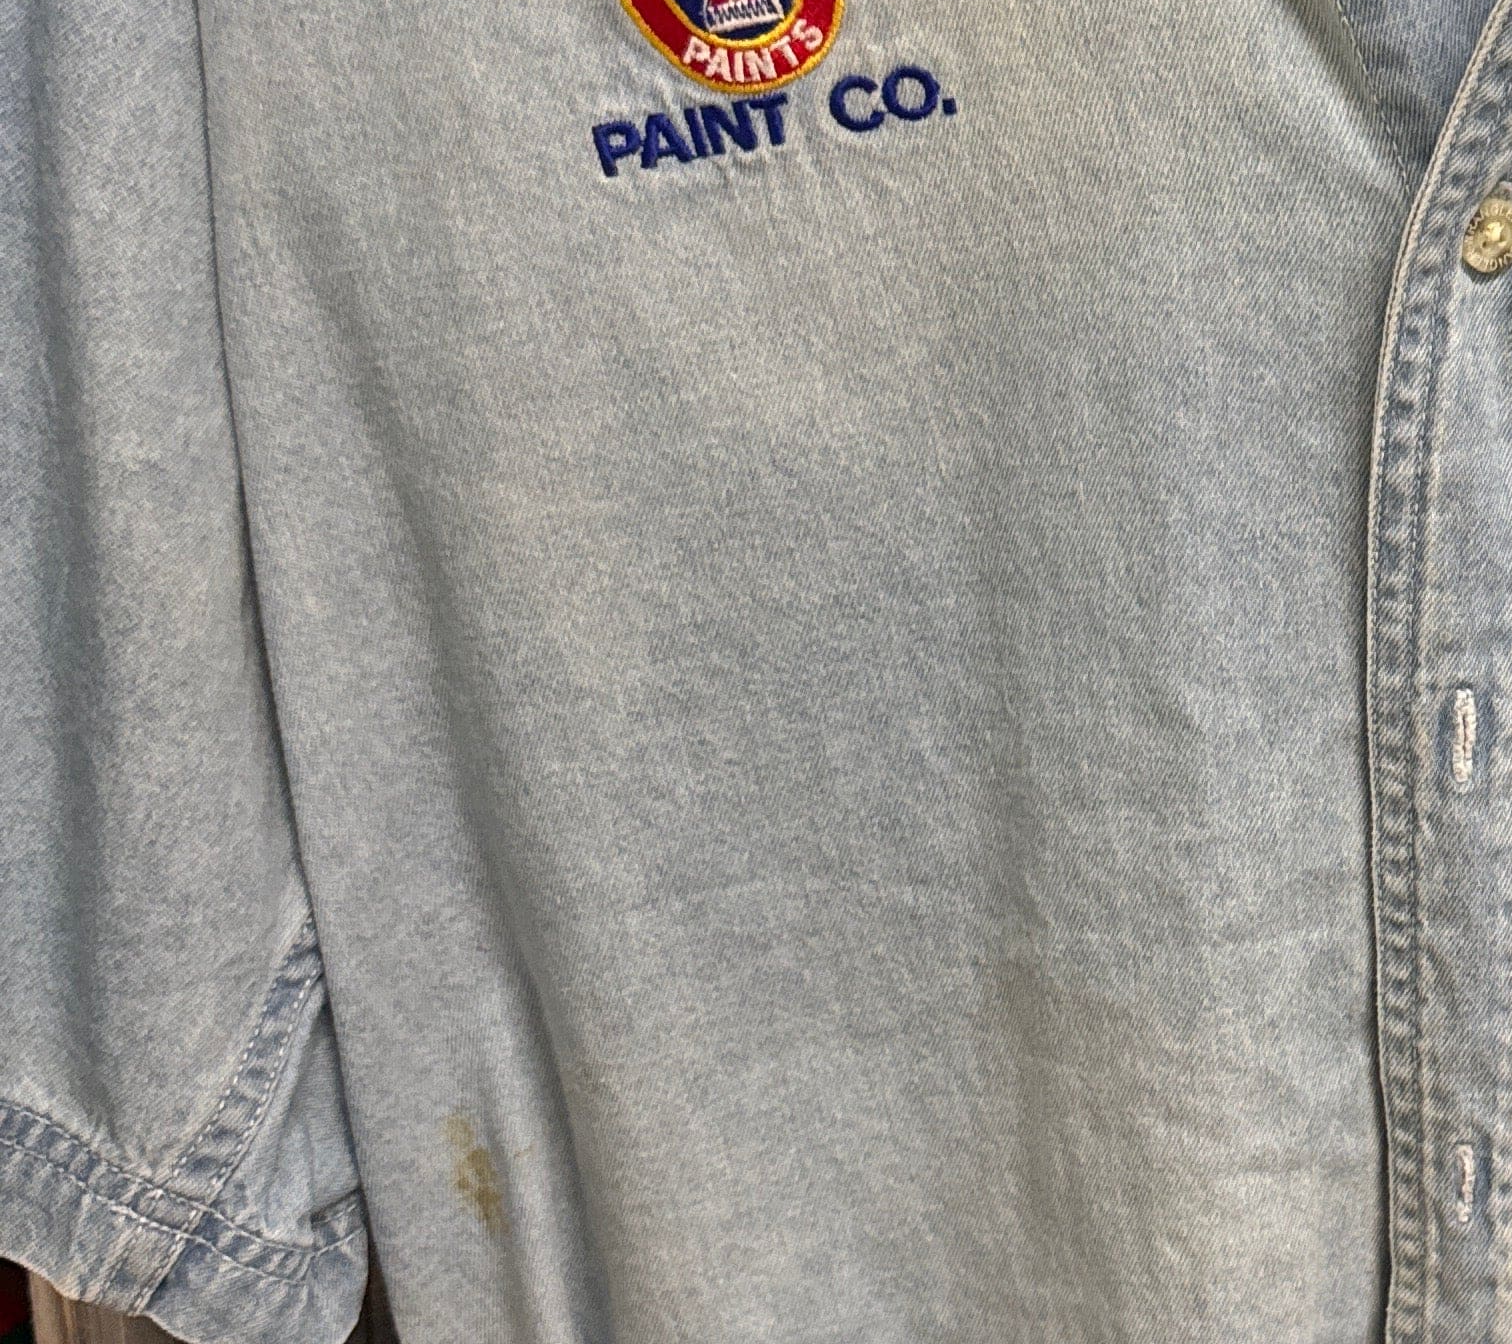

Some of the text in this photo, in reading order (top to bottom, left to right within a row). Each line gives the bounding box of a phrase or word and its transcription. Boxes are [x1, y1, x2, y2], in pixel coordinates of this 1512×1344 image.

[682, 17, 824, 83] PAINTS
[592, 64, 957, 178] PAINT CO.
